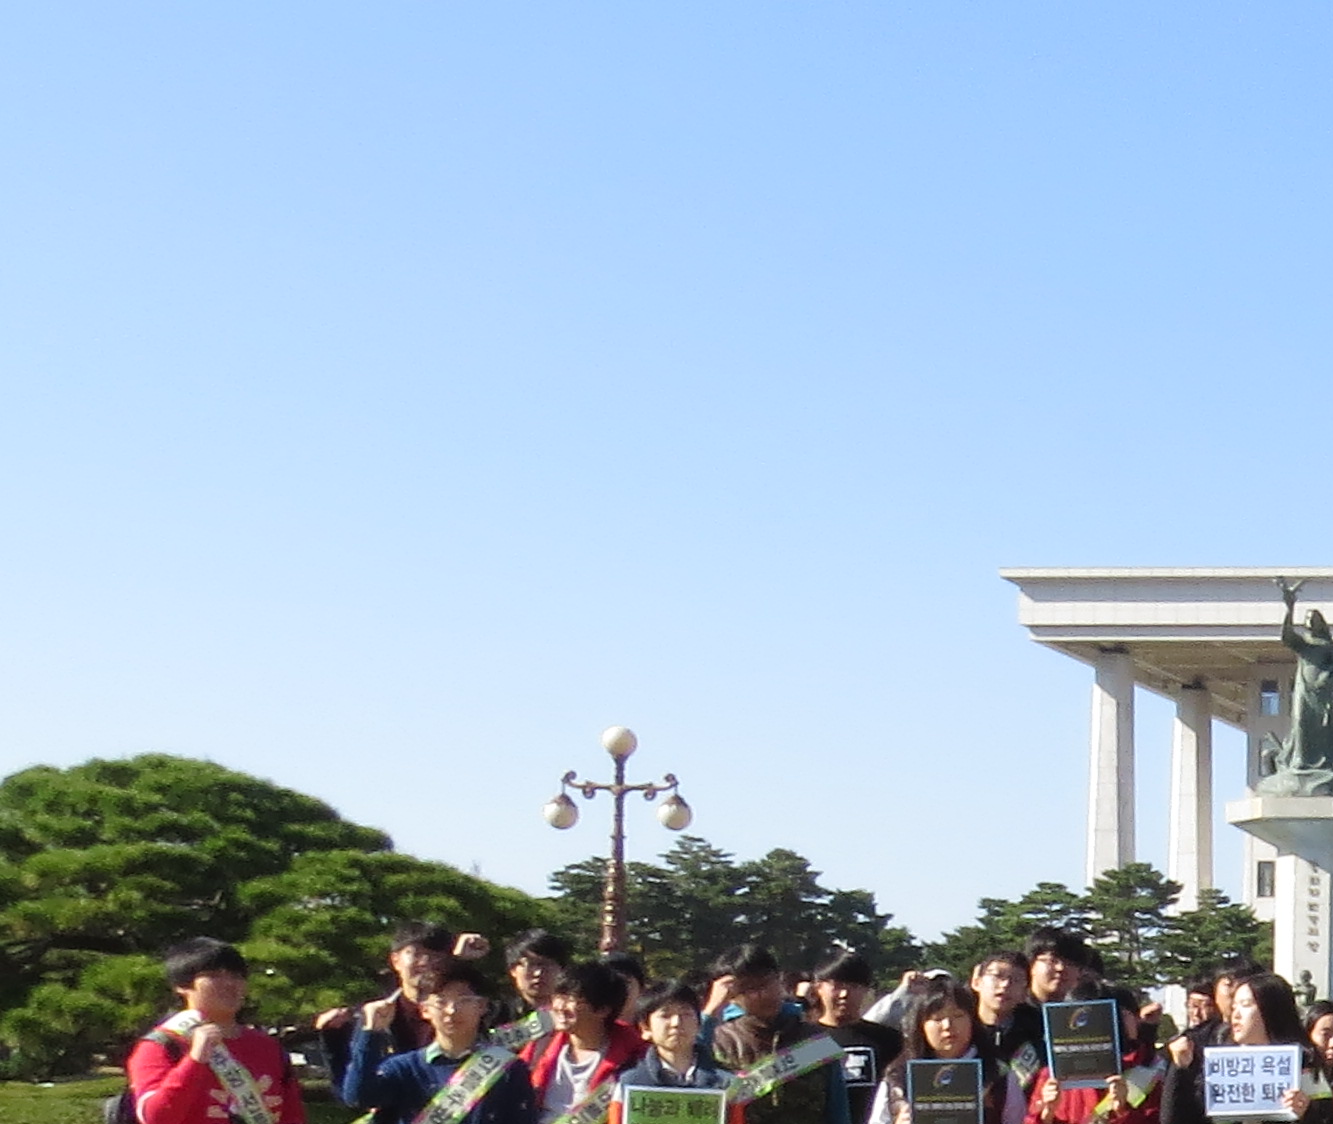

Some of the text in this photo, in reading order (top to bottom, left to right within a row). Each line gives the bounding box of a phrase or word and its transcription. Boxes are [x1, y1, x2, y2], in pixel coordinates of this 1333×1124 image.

[1209, 1055, 1291, 1077] 비방과 욕설
[1209, 1082, 1255, 1103] 완전한
